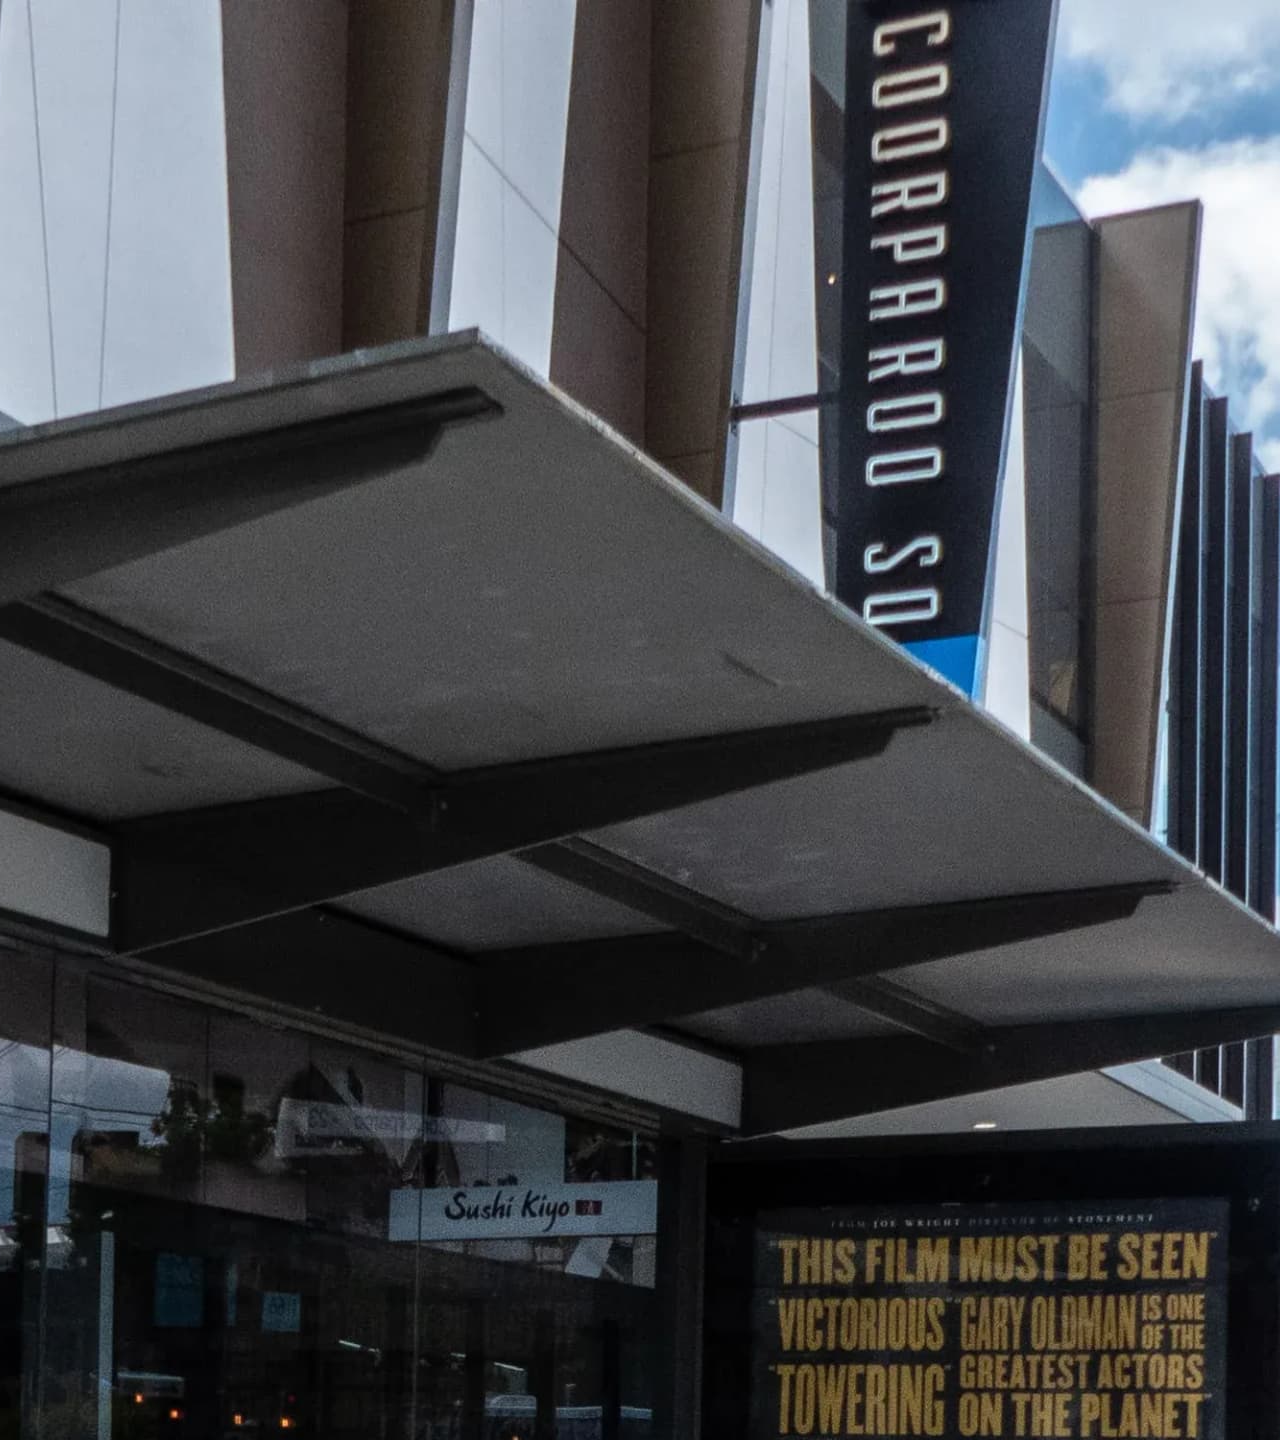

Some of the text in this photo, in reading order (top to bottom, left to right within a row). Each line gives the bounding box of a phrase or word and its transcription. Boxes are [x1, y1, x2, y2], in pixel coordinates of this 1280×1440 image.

[865, 10, 950, 487] COORPAROO
[444, 1189, 571, 1232] Sushi Kiyo
[865, 1236, 949, 1284] FILM
[958, 1234, 1061, 1283] MUST
[1067, 1233, 1109, 1281] BE
[1030, 1293, 1137, 1351] OLDMAN
[1141, 1293, 1162, 1321] IS
[1166, 1293, 1205, 1320] ONE
[1141, 1324, 1205, 1351] OF THE
[959, 1353, 1205, 1390] GREATEST ACTORS
[958, 1392, 1003, 1437] ON
[1012, 1392, 1072, 1438] THE
